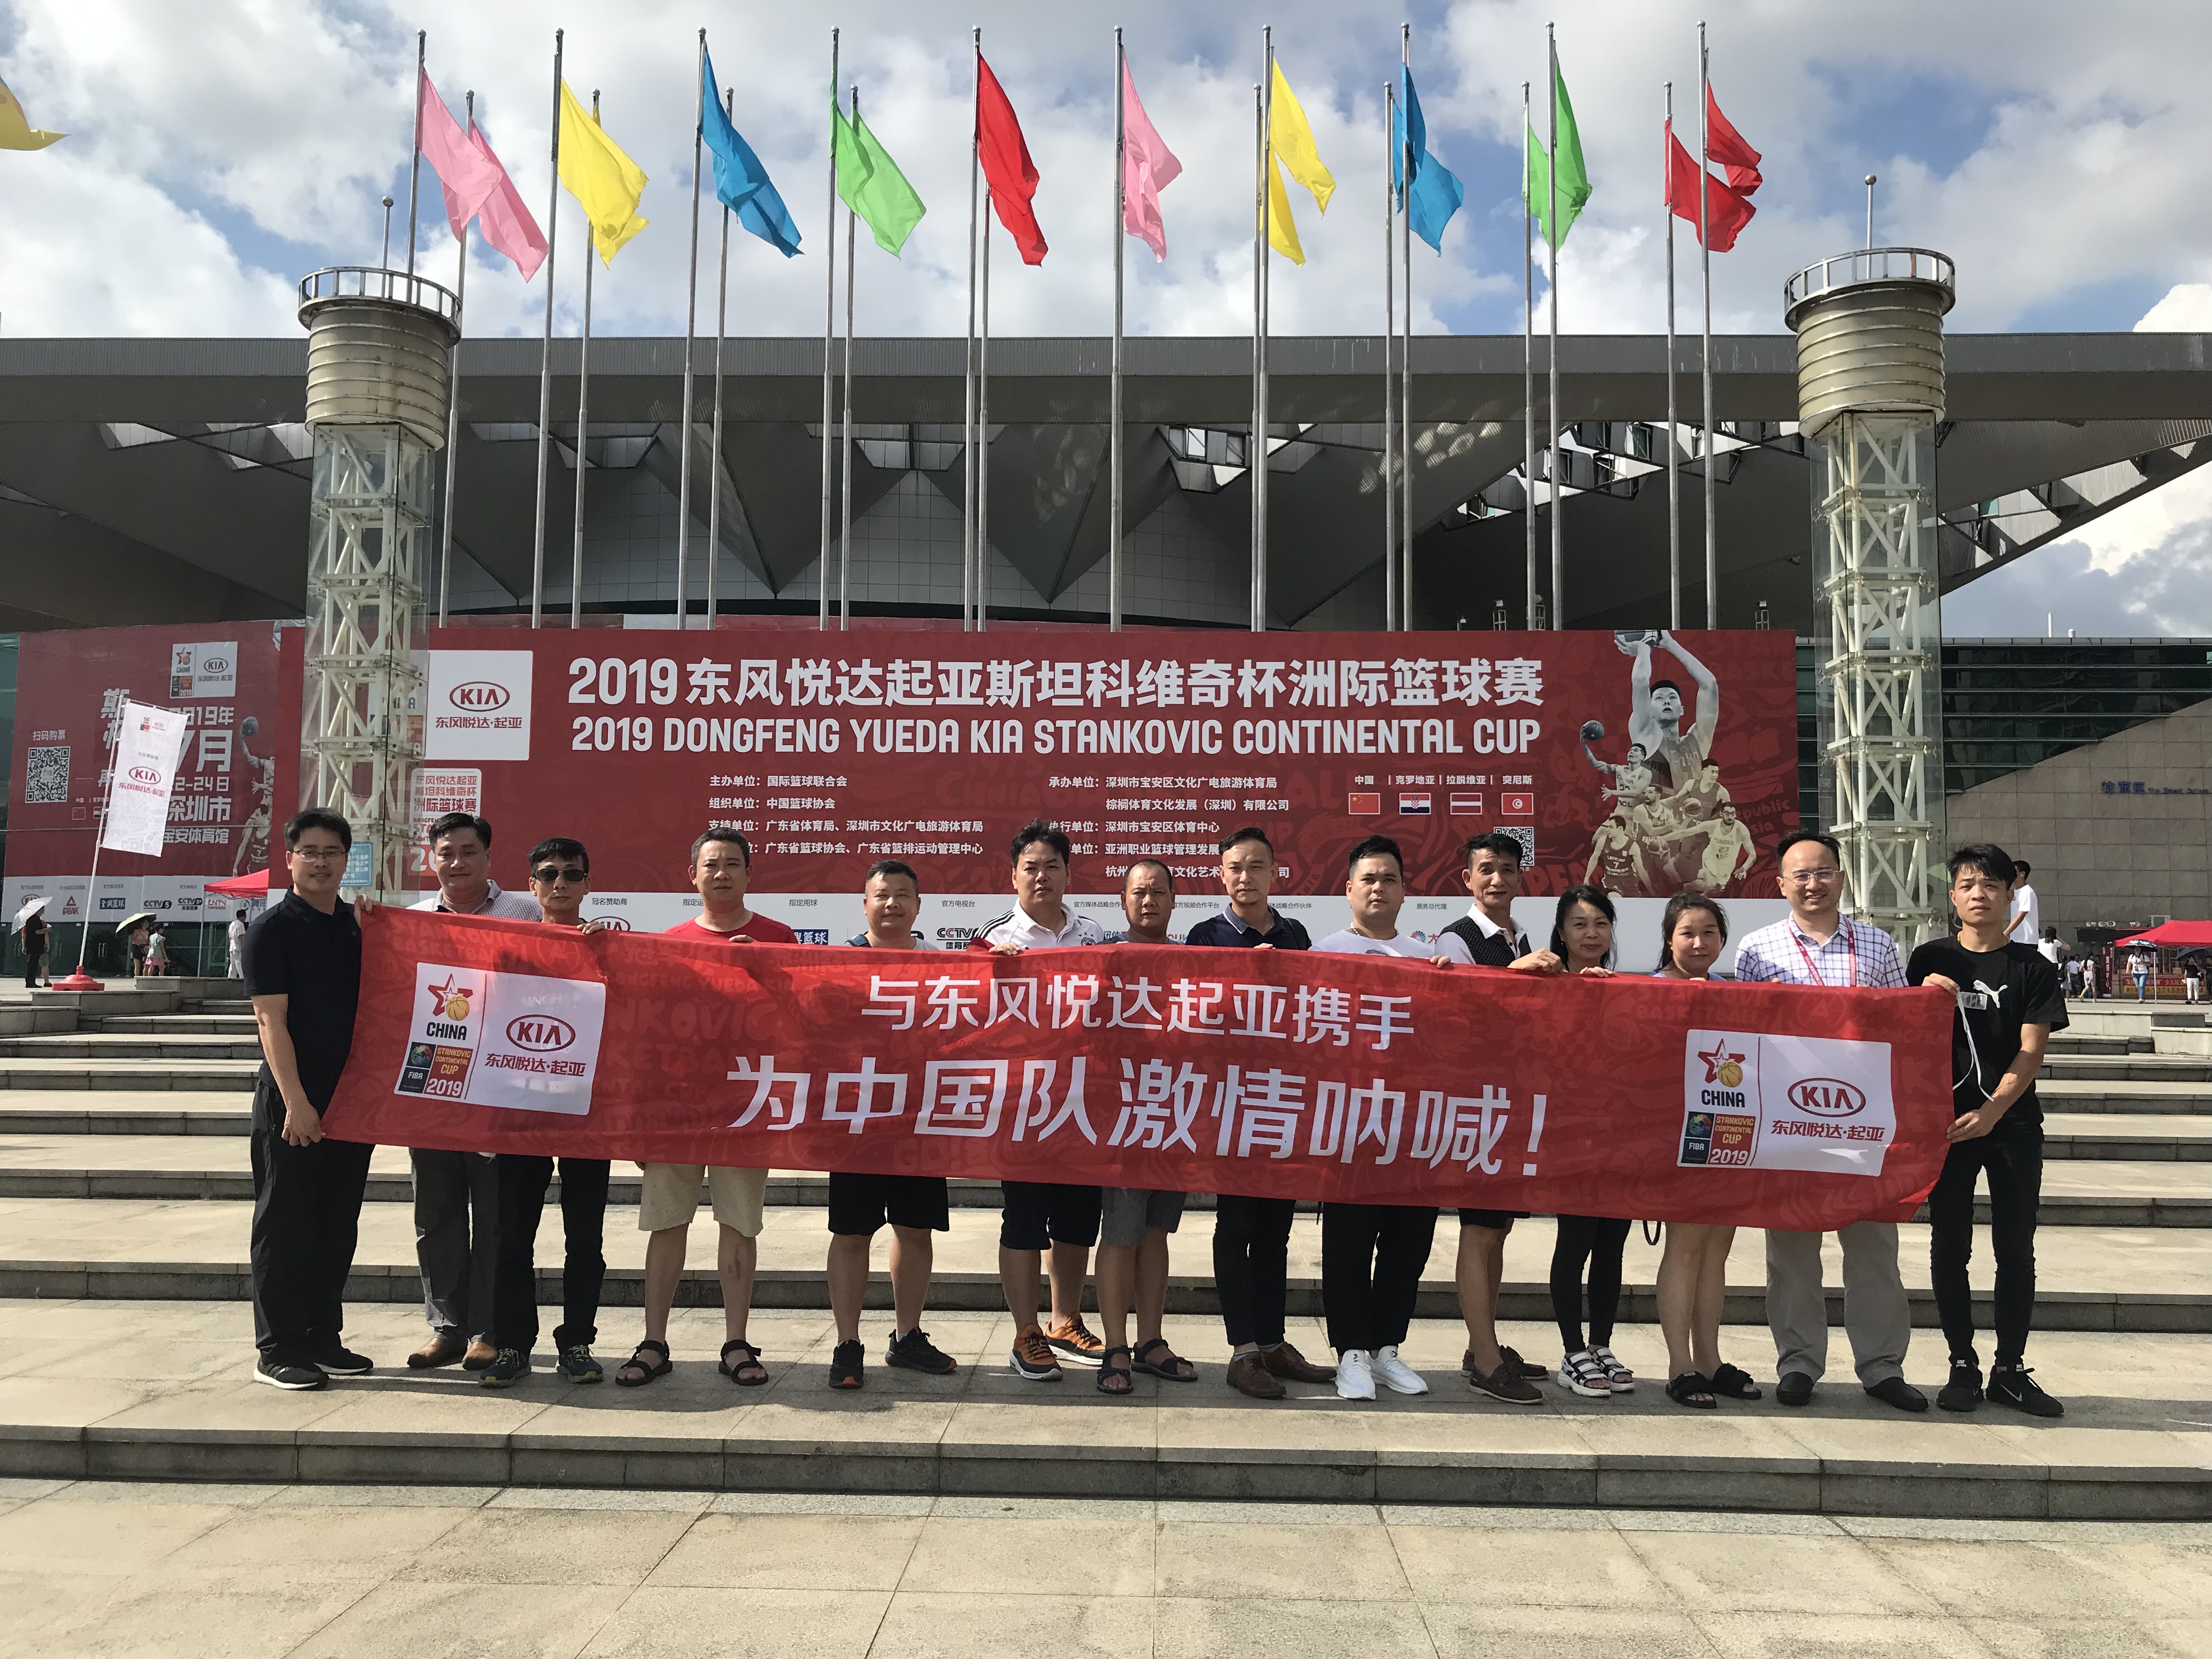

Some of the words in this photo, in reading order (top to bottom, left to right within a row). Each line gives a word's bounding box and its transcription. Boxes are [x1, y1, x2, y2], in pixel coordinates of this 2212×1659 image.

[208, 661, 224, 669] KIA
[460, 689, 498, 706] KIA
[436, 716, 522, 729] 东风悦达·起亚
[33, 729, 66, 741] 扫码购票
[572, 716, 653, 752] 2019
[664, 718, 839, 753] DONGFENG
[849, 719, 959, 753] YUEDA
[970, 719, 1023, 753] KIA
[1034, 719, 1223, 754] STANKOVIC
[1233, 718, 1463, 754] CONTINENTAL
[1474, 719, 1541, 754] CUP
[134, 769, 157, 783] KIA
[415, 775, 477, 785] 东风悦达起亚
[709, 775, 848, 787] 主办单位：国际篮球联合会
[1355, 775, 1374, 785] 中国
[1395, 775, 1435, 785] 克罗地亚
[1446, 775, 1486, 785] 拉脱维亚
[1502, 775, 1532, 785] 突尼斯
[415, 786, 477, 797] 斯坦科维奇杯
[414, 798, 477, 812] 洲际篮球赛
[709, 797, 836, 809] 组织单位：中国篮球协会
[591, 898, 628, 906] 冠名赞助商
[861, 974, 1414, 1051] 与东风悦达起亚携手
[426, 1022, 467, 1041] CHINA
[517, 1023, 562, 1046] KIA
[437, 1047, 471, 1058] STANKOVIC
[435, 1056, 469, 1065] CONTINENTAL
[484, 1053, 586, 1077] 东风悦达·起亚
[408, 1071, 423, 1080] FIBA
[441, 1064, 459, 1075] CUP
[426, 1078, 462, 1097] 2019
[1701, 1089, 1745, 1108] CHINA
[1800, 1086, 1854, 1110] KIA
[725, 1056, 1548, 1177] 为中国队激情呐喊！
[1716, 1116, 1754, 1126] STANKOVIC
[1715, 1125, 1752, 1134] CONTINENTAL
[1770, 1120, 1885, 1142] 东风悦达·起亚
[1722, 1133, 1742, 1144] CUP
[1689, 1142, 1705, 1151] FIBA
[1709, 1148, 1748, 1164] 2019
